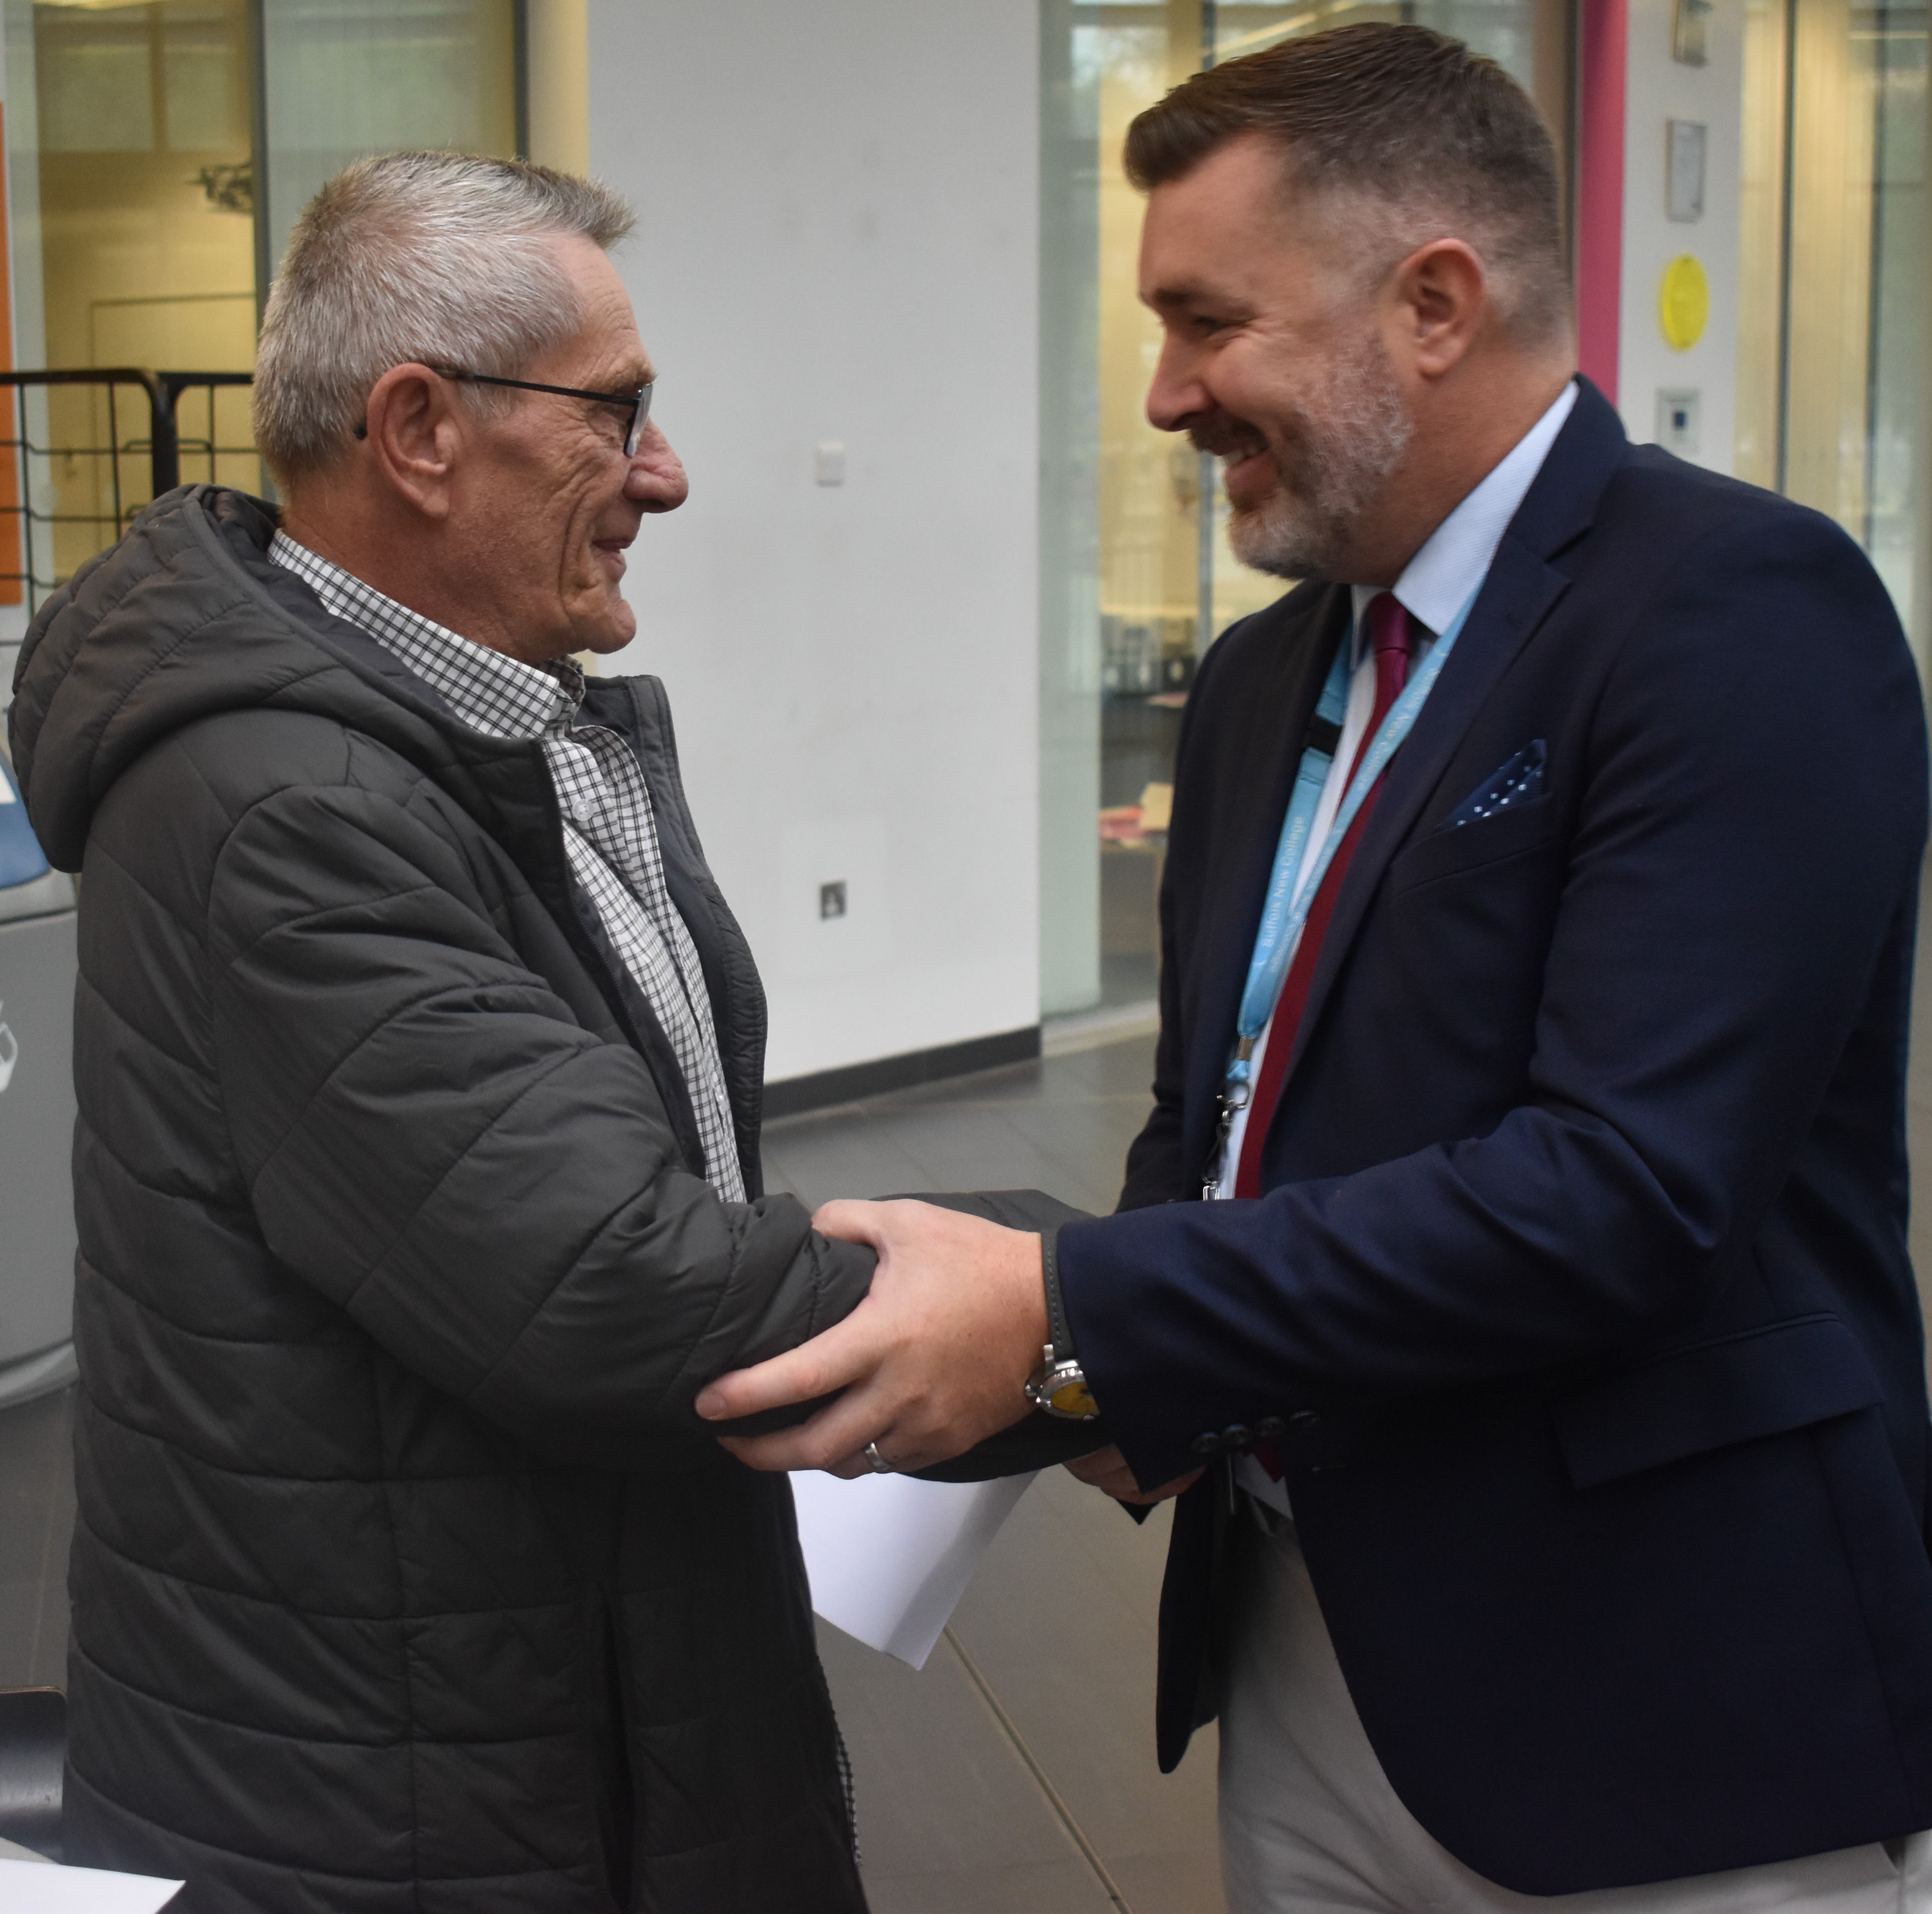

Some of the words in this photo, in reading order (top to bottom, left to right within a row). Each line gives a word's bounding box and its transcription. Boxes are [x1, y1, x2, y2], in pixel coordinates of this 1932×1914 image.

[1280, 816, 1306, 866] College
[1273, 869, 1290, 897] New
[1262, 901, 1283, 947] Suffolk
